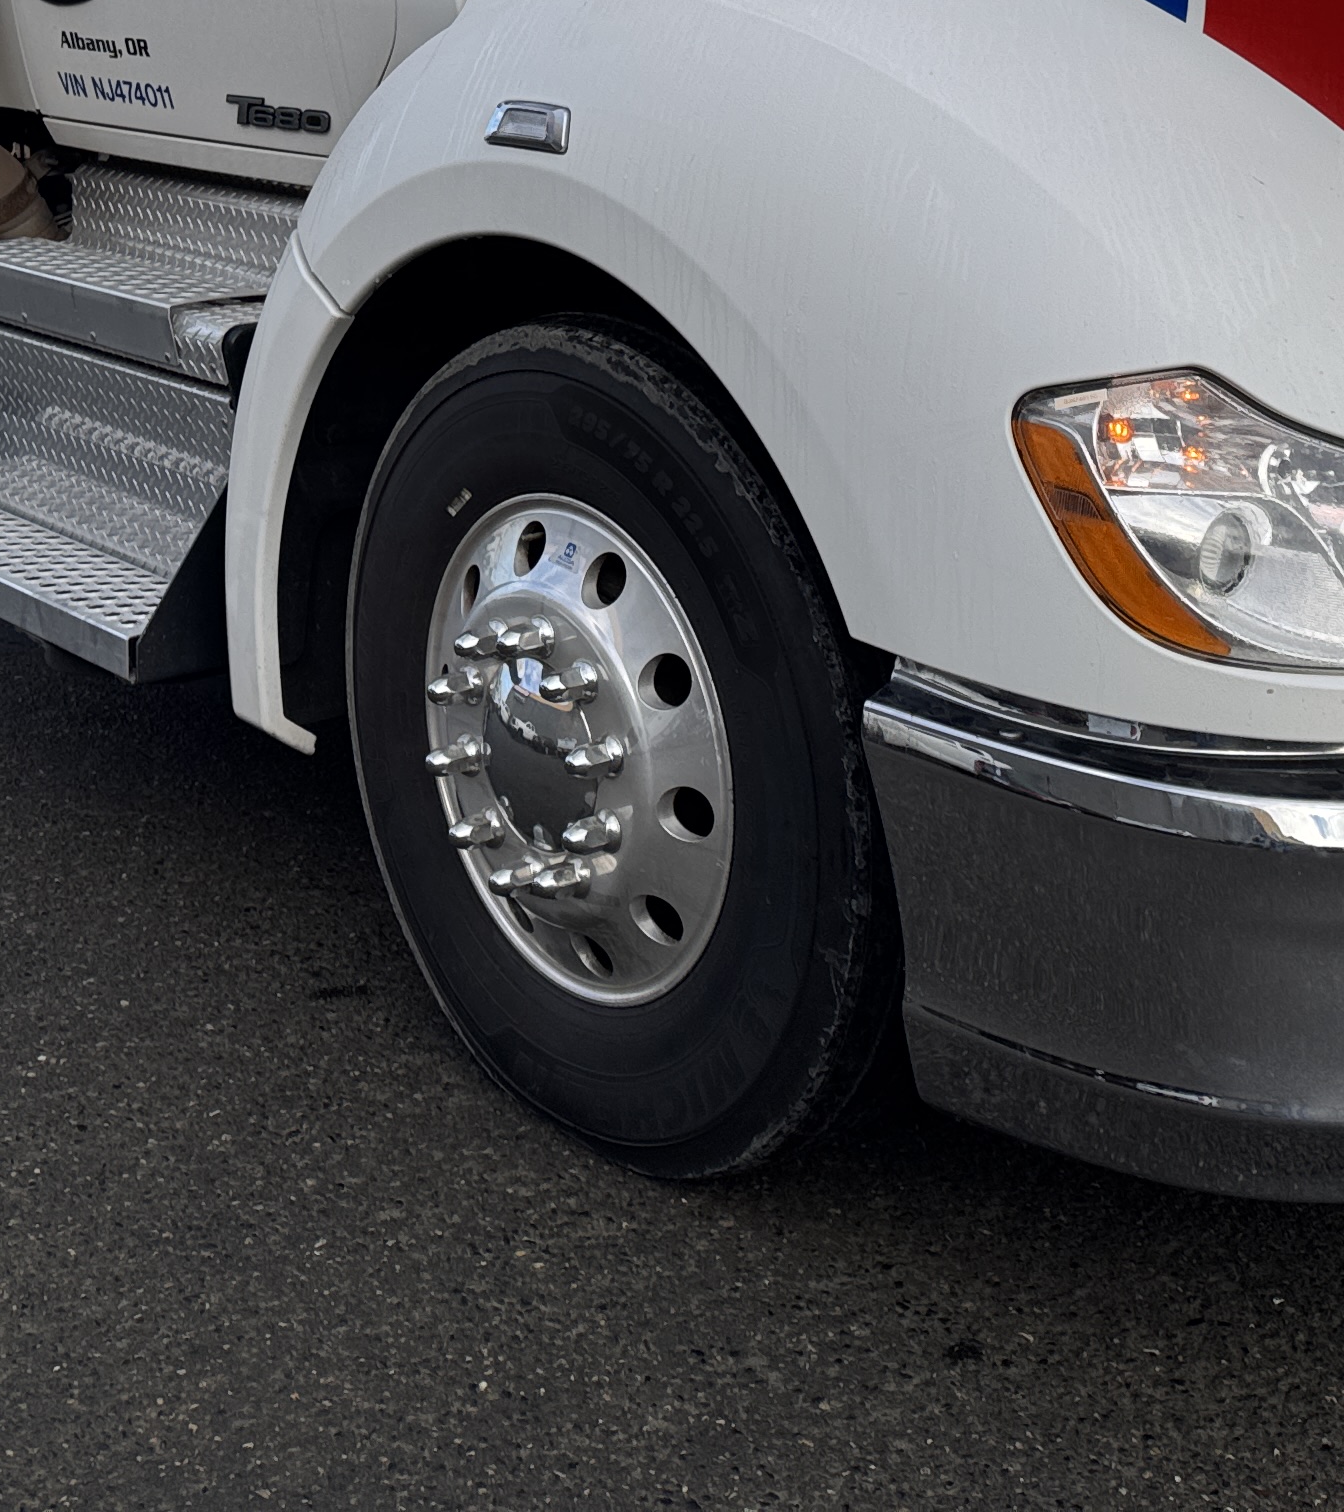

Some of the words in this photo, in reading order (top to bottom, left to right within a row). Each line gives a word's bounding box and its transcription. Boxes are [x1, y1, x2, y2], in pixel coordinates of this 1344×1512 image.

[60, 30, 124, 59] Albany,
[125, 37, 151, 58] OR
[57, 71, 89, 99] VIN
[90, 76, 175, 110] NJ474011
[225, 93, 332, 134] T680
